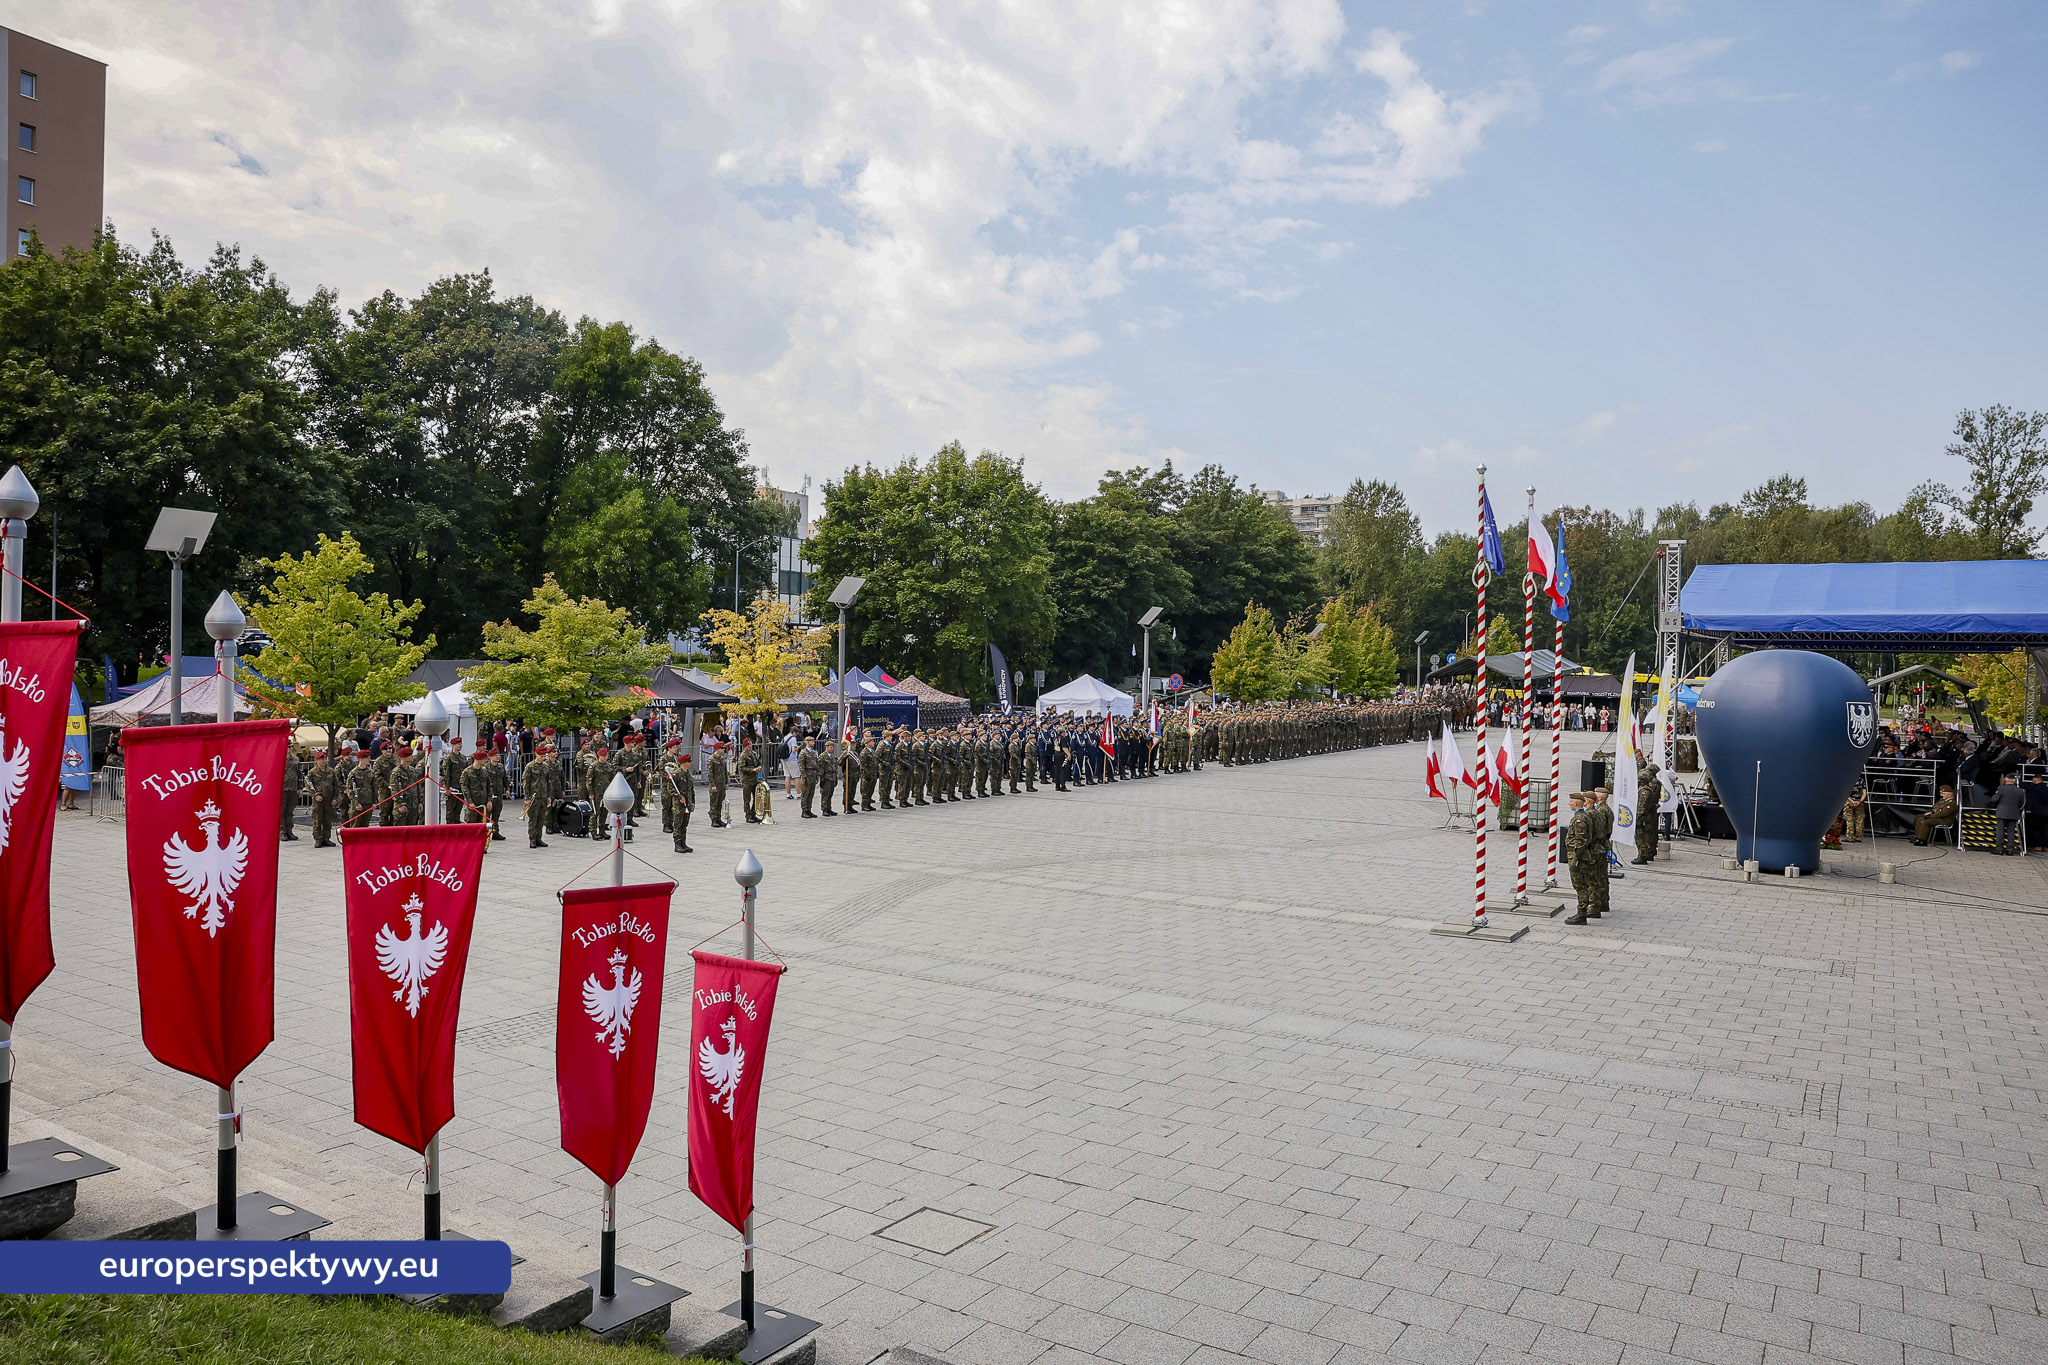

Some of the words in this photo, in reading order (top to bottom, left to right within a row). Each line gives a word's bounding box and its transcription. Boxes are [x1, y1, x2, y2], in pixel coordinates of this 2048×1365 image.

[141, 766, 209, 801] Tobie
[210, 754, 263, 796] Polsko
[355, 863, 414, 895] Tobie
[416, 853, 463, 892] Polsko
[571, 922, 617, 949] Tobie
[618, 911, 656, 943] Polsko
[694, 988, 732, 1011] Tobie
[734, 983, 758, 1021] Polsko
